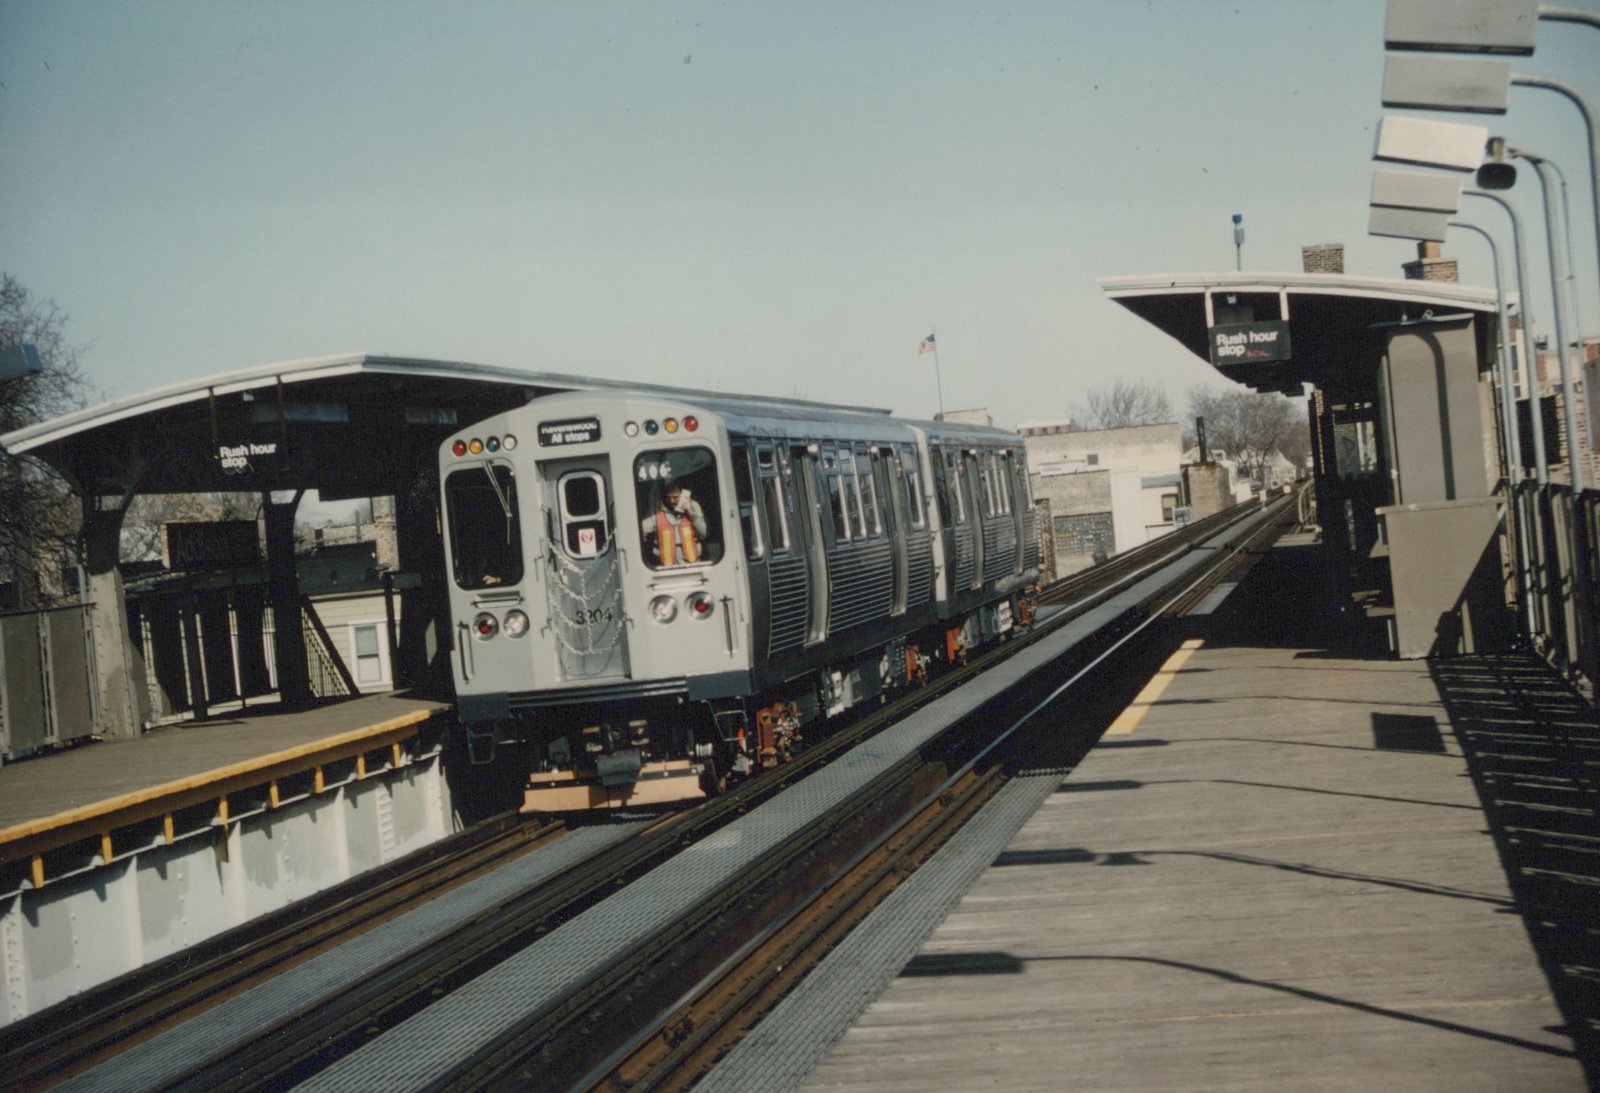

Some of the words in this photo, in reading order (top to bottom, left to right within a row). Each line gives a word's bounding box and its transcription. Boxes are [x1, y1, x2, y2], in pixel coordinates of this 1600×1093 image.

[1216, 332, 1247, 346] Rush
[1249, 330, 1278, 343] hour
[1217, 344, 1246, 357] stop
[551, 433, 563, 444] All
[565, 432, 590, 443] stops
[219, 444, 249, 458] Rush
[250, 443, 277, 455] hour
[221, 456, 248, 469] stop
[575, 608, 613, 625] 3204
